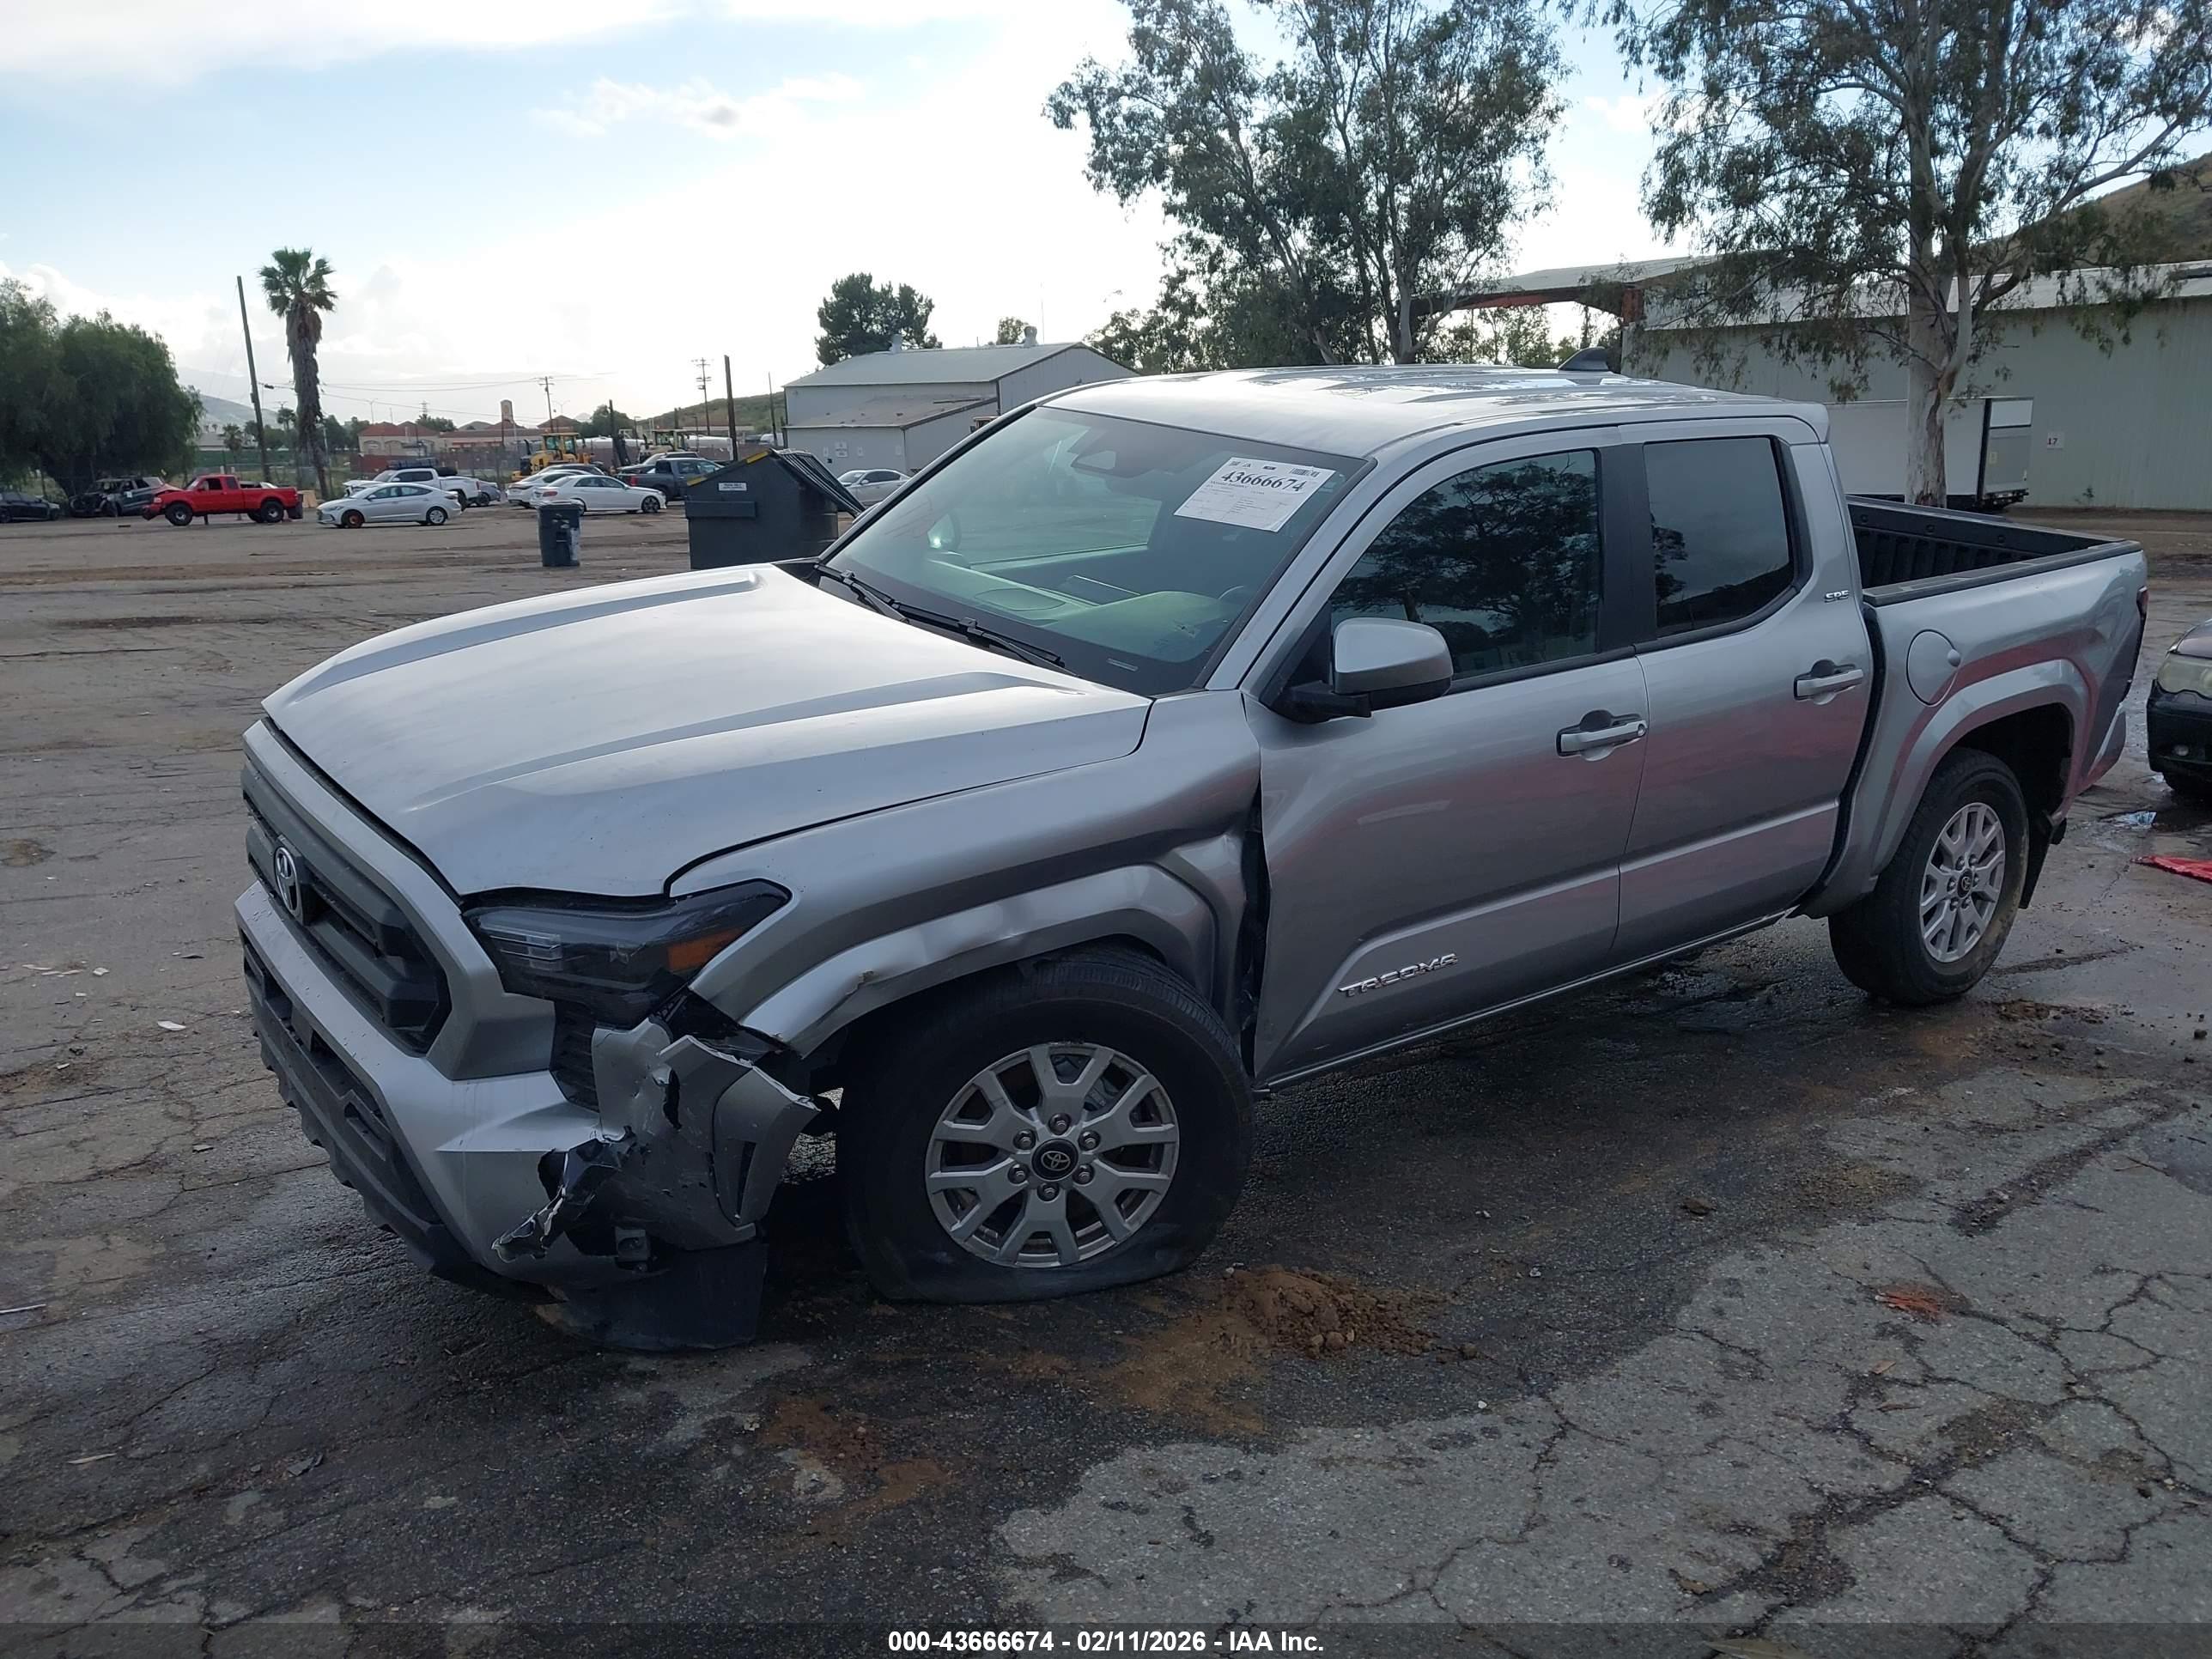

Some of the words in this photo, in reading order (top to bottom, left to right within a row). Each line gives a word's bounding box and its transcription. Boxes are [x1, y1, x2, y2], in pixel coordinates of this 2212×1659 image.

[1221, 470, 1307, 492] 43666674
[1825, 590, 1850, 603] SR5
[1339, 953, 1458, 997] TACOMA
